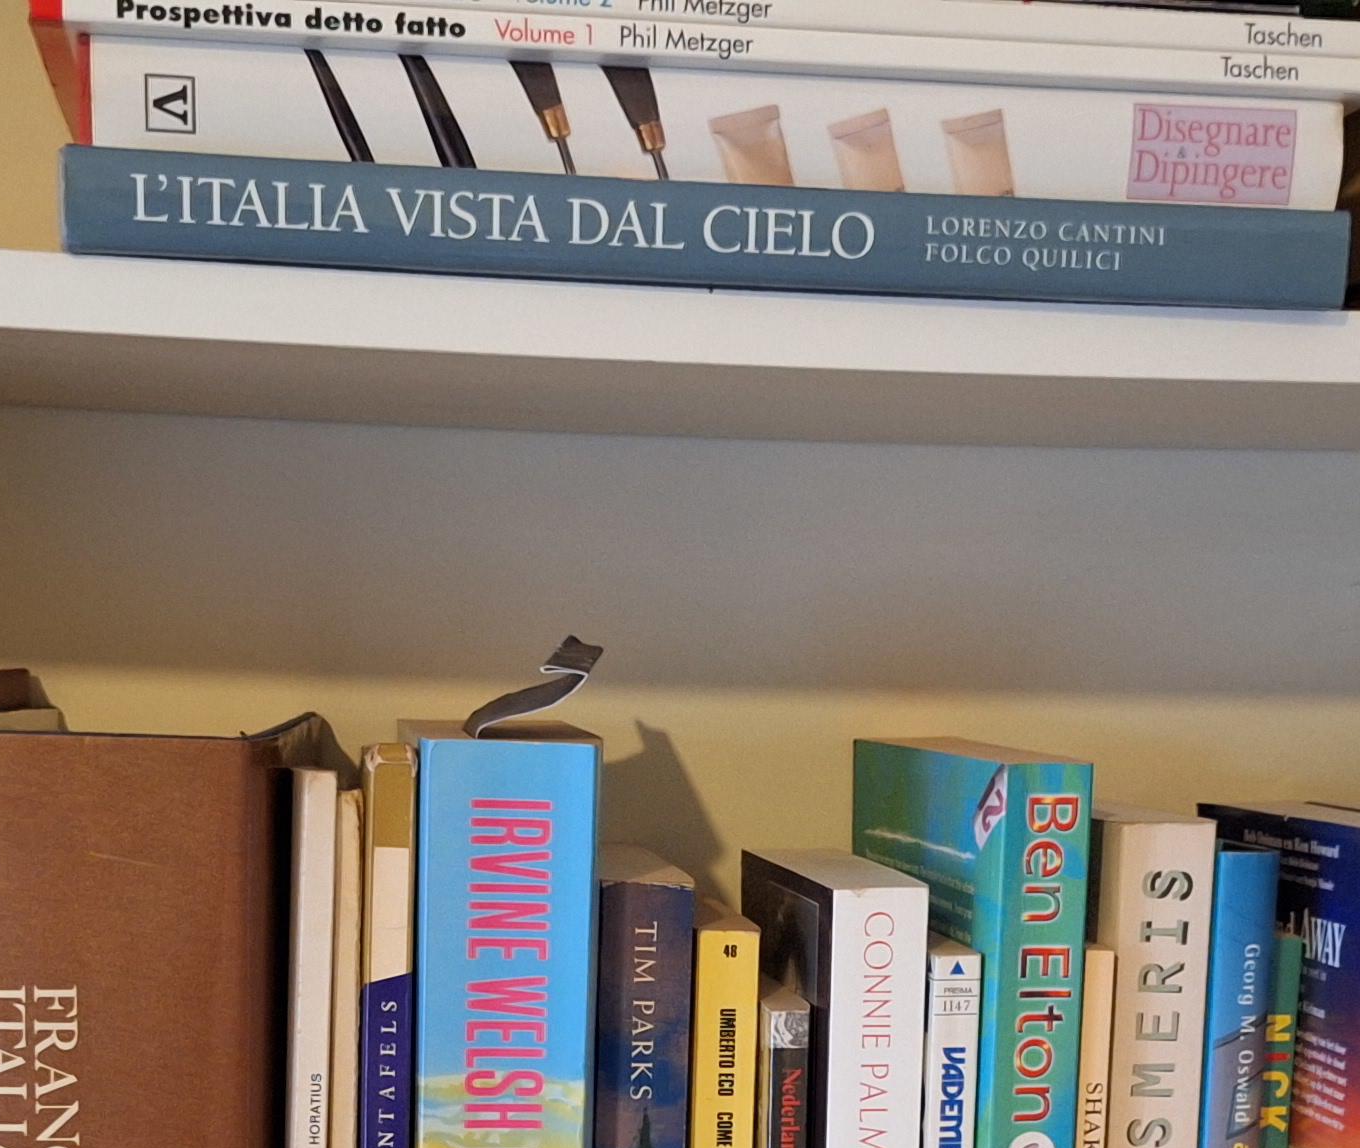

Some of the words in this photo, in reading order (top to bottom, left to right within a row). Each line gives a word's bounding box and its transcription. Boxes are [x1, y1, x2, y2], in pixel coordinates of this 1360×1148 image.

[305, 13, 383, 34] detto
[396, 12, 466, 38] fatto
[494, 19, 575, 46] Volume
[619, 25, 657, 50] Phil
[666, 30, 754, 59] Metzger
[1220, 56, 1299, 82] Taschen
[1244, 22, 1323, 49] Taschen
[130, 173, 369, 234] L'ITALIA
[384, 188, 550, 244] VISTA
[566, 199, 685, 251] DAL
[702, 205, 876, 260] CIELO
[926, 216, 1048, 241] LORENZO
[1057, 223, 1167, 246] CANTINI
[924, 243, 1013, 267] FOLCO
[1022, 247, 1123, 272] QUILICI
[466, 798, 553, 961] IRVINE
[1020, 794, 1082, 923] Ben
[633, 921, 659, 984] TIM
[861, 911, 895, 1050] CONNIE
[1237, 943, 1261, 1006] Georg
[718, 1008, 737, 1069] UMBERTO
[941, 999, 971, 1013] 1147
[1012, 946, 1073, 1123] Elton
[1126, 869, 1194, 1148] SMERIS
[462, 976, 549, 1130] WELSH
[630, 1000, 656, 1101] PARKS
[717, 1072, 735, 1097] ECO
[1260, 1013, 1295, 1133] NICK
[308, 1072, 323, 1146] HORATIUS
[1233, 1048, 1254, 1127] Oswald
[716, 1111, 734, 1148] COME
